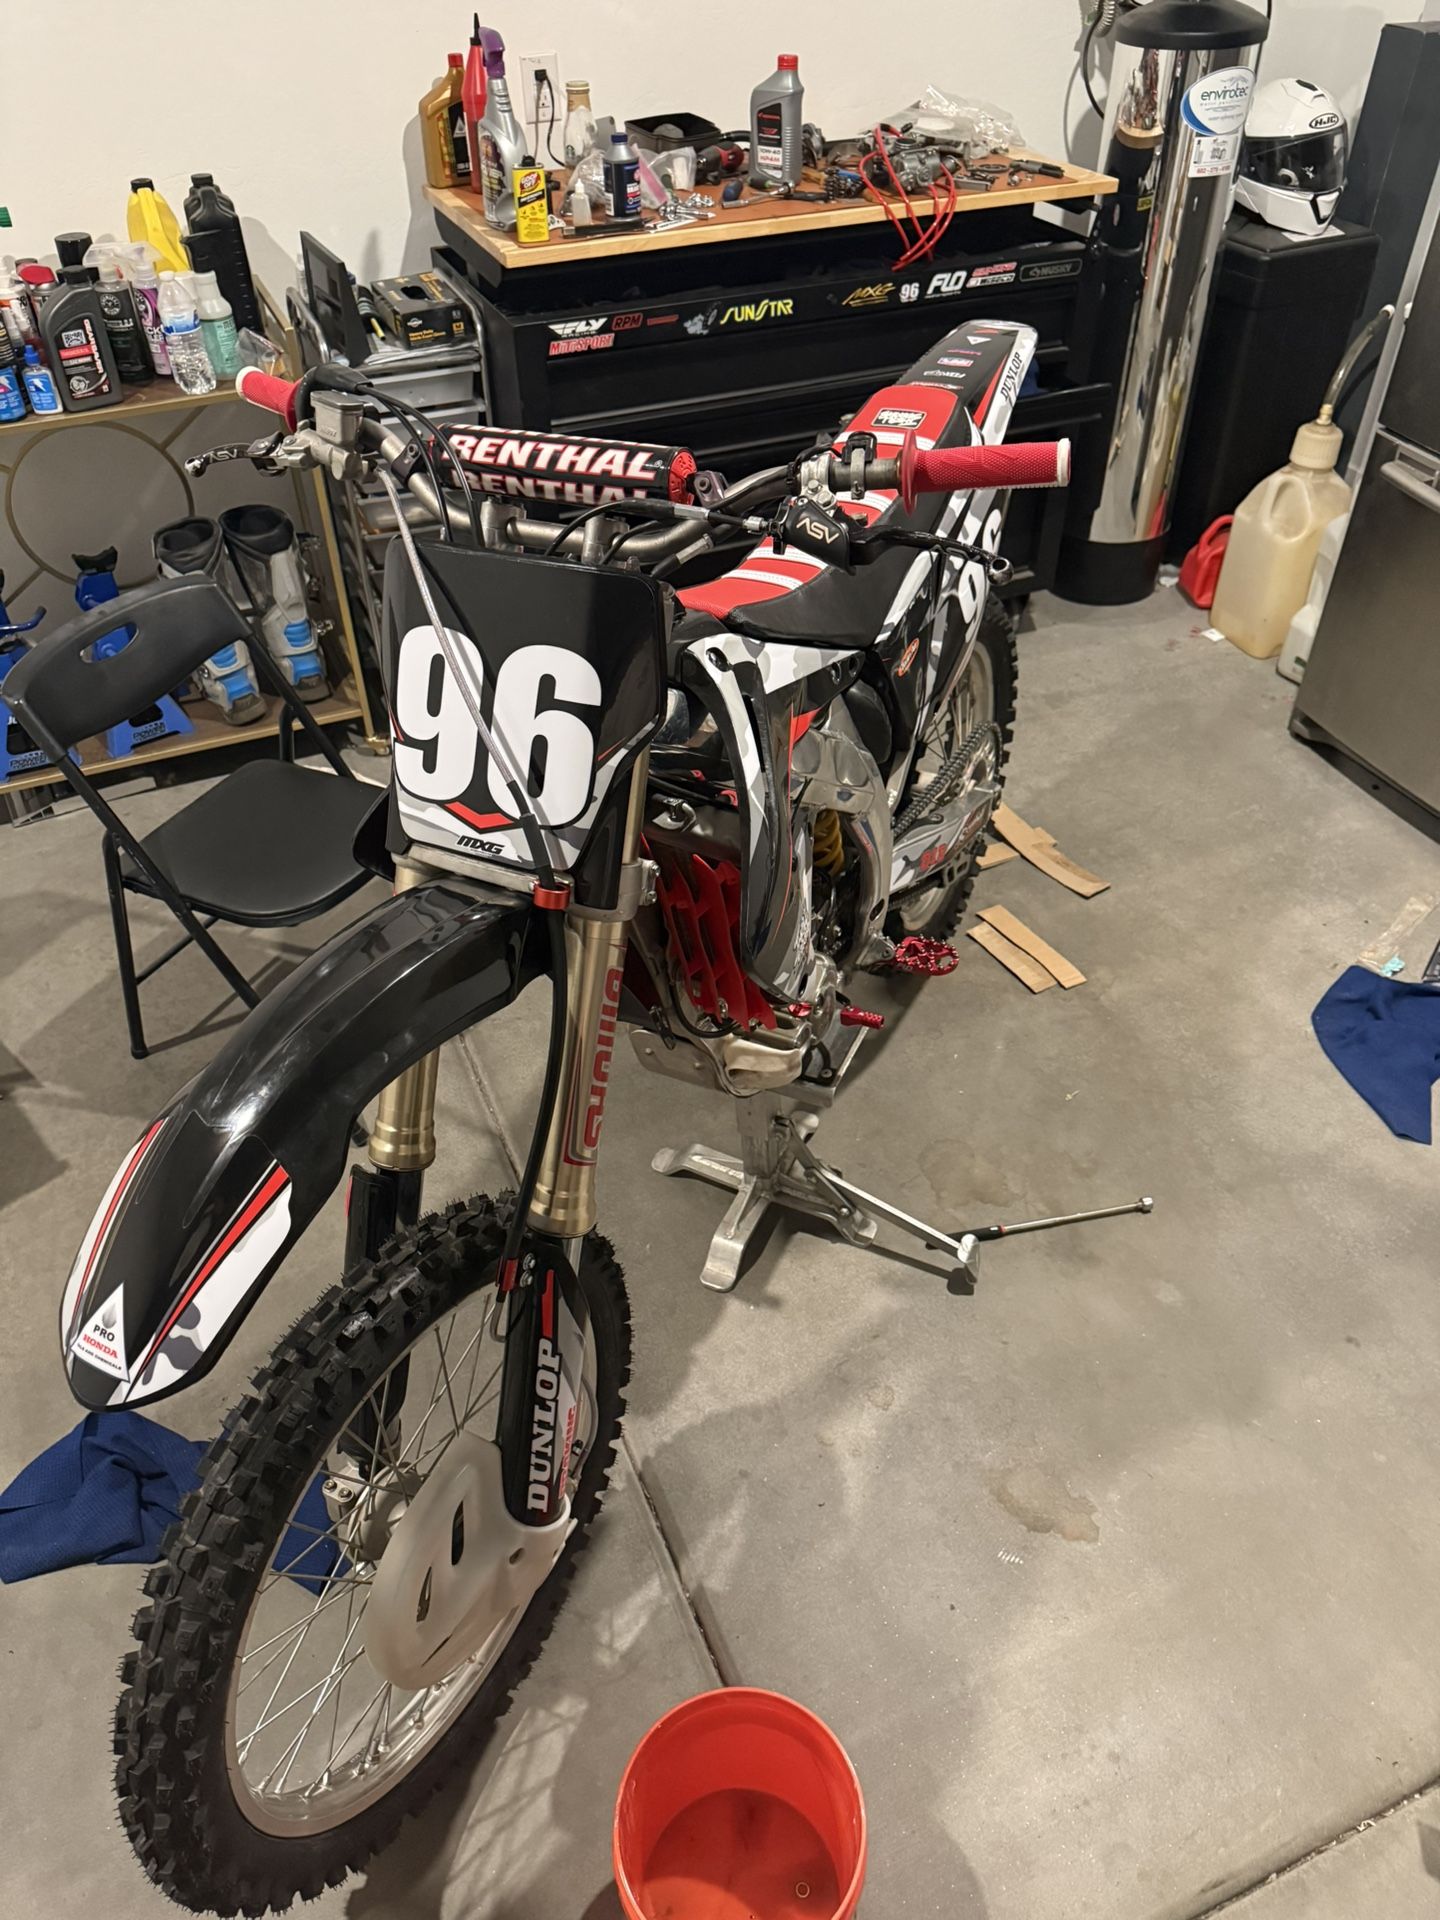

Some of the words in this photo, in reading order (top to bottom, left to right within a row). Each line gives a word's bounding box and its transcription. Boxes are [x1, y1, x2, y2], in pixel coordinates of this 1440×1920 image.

[1315, 116, 1338, 127] HJC
[1040, 264, 1072, 276] HUSKY
[899, 282, 920, 300] 96
[927, 271, 967, 295] FLO
[548, 317, 608, 335] FLY
[614, 314, 641, 329] RPM
[999, 351, 1023, 401] DUNLOP
[208, 448, 238, 464] ASV
[441, 433, 657, 481] RENTHAL
[796, 517, 841, 545] ASV
[394, 624, 602, 828] 96
[456, 834, 506, 856] MXG
[93, 1324, 115, 1342] PRO
[83, 1334, 118, 1359] HONDA
[528, 1337, 561, 1513] DUNLOP
